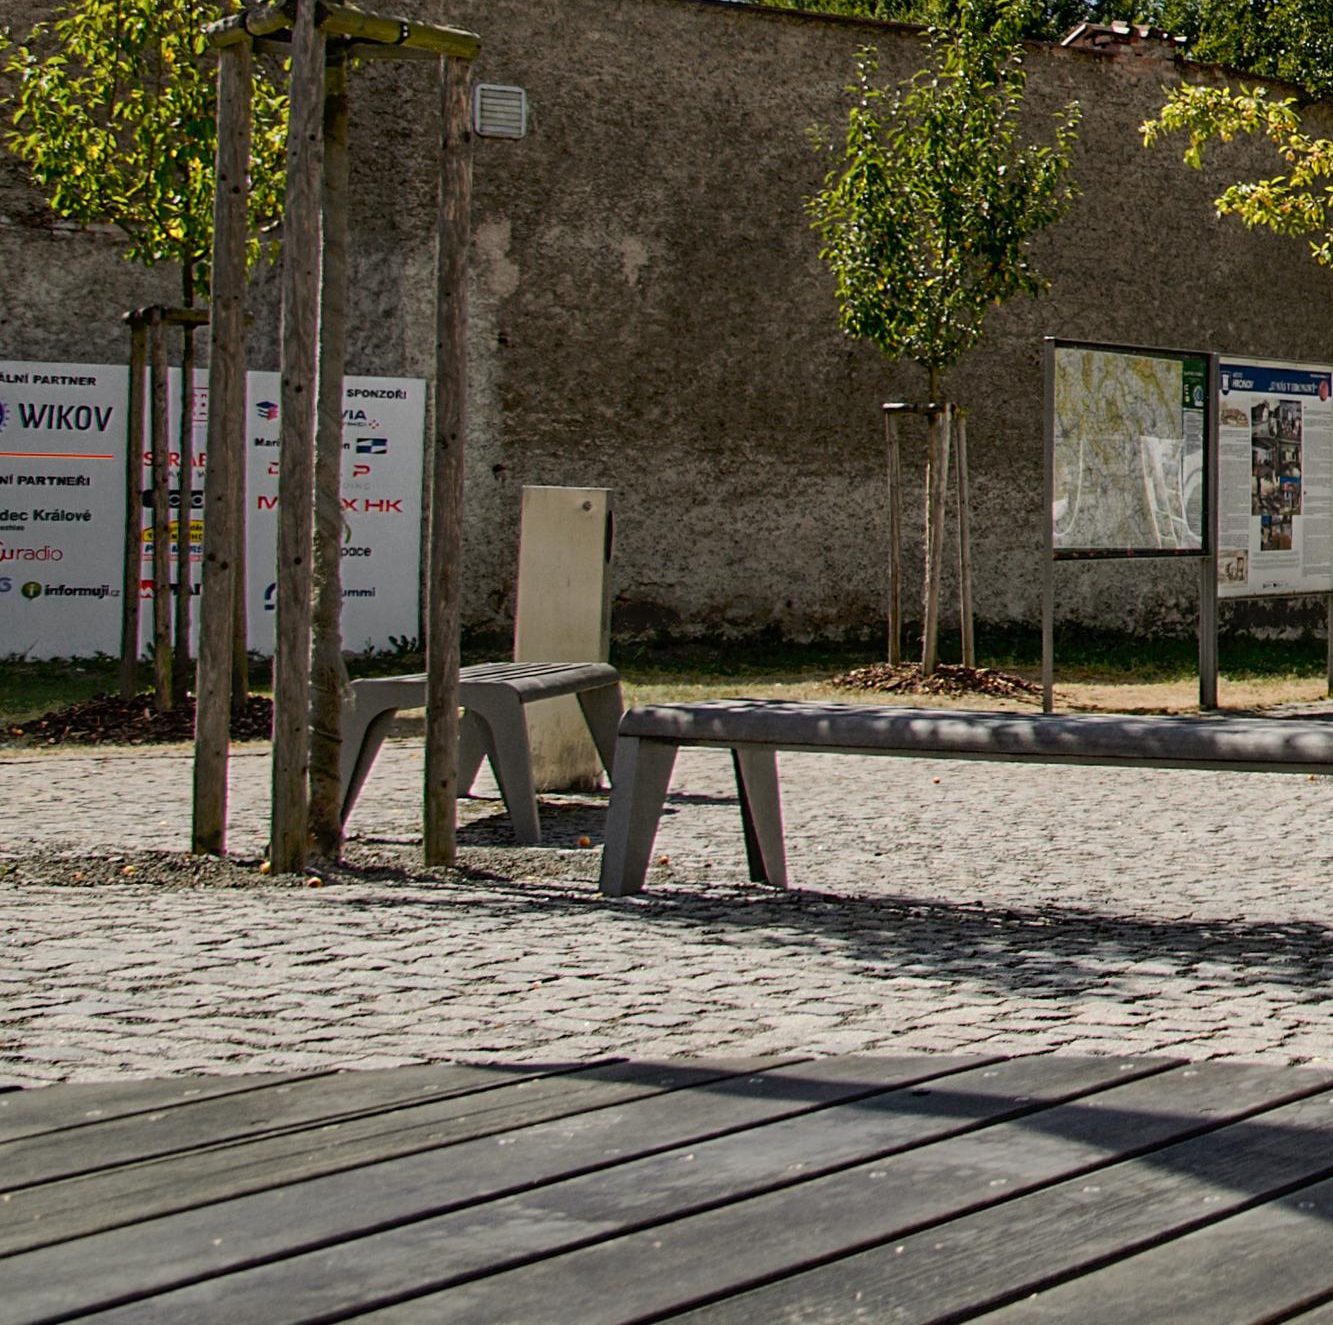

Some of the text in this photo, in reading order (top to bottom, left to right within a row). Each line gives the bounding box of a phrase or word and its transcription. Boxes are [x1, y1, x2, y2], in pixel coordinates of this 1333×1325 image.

[33, 375, 97, 386] PARTNER
[346, 388, 407, 400] SPONZOŘI
[18, 403, 113, 432] WIKOV
[17, 475, 91, 487] PARTNEŘI
[364, 499, 403, 513] HK
[33, 509, 92, 522] Králové
